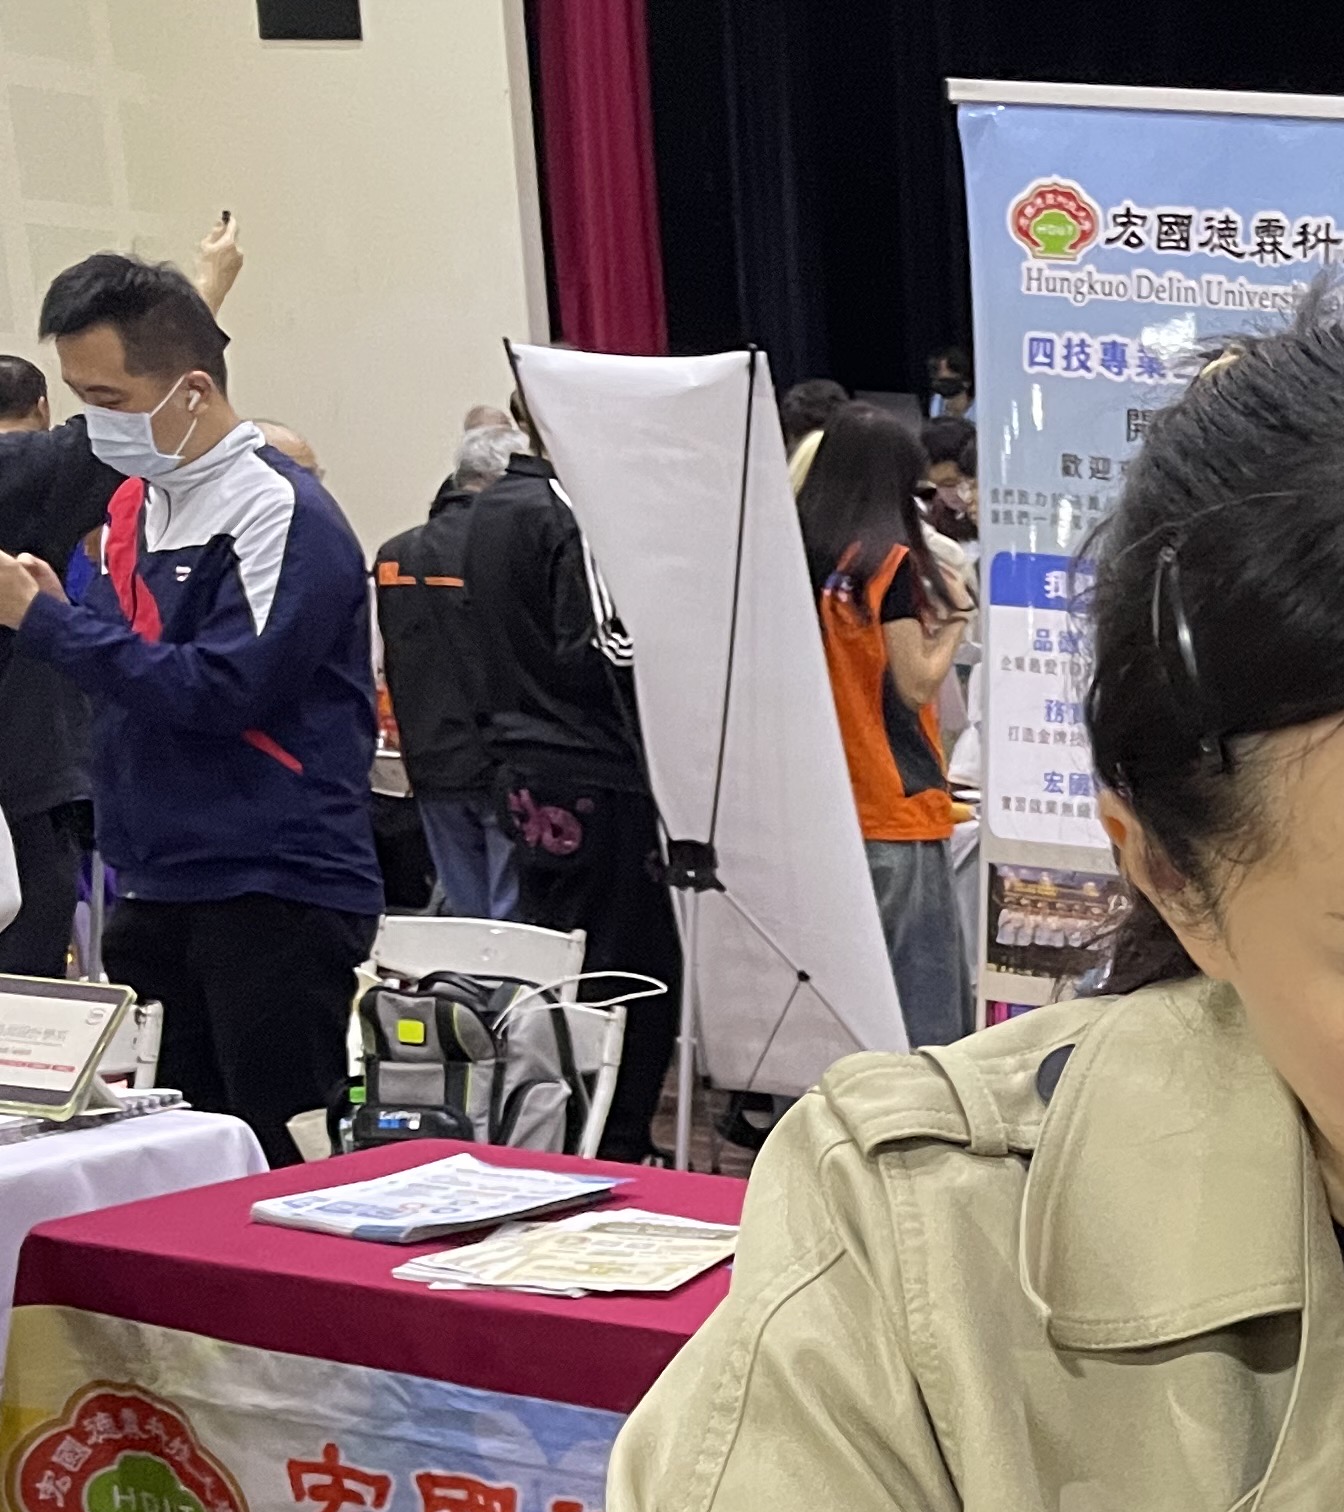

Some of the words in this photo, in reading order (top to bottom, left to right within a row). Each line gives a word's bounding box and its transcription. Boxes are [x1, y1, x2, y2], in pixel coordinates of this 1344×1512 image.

[1025, 266, 1128, 302] Hungkuo
[1135, 273, 1197, 303] Delin
[1205, 279, 1316, 315] Univers
[1028, 336, 1188, 380] 四技專業
